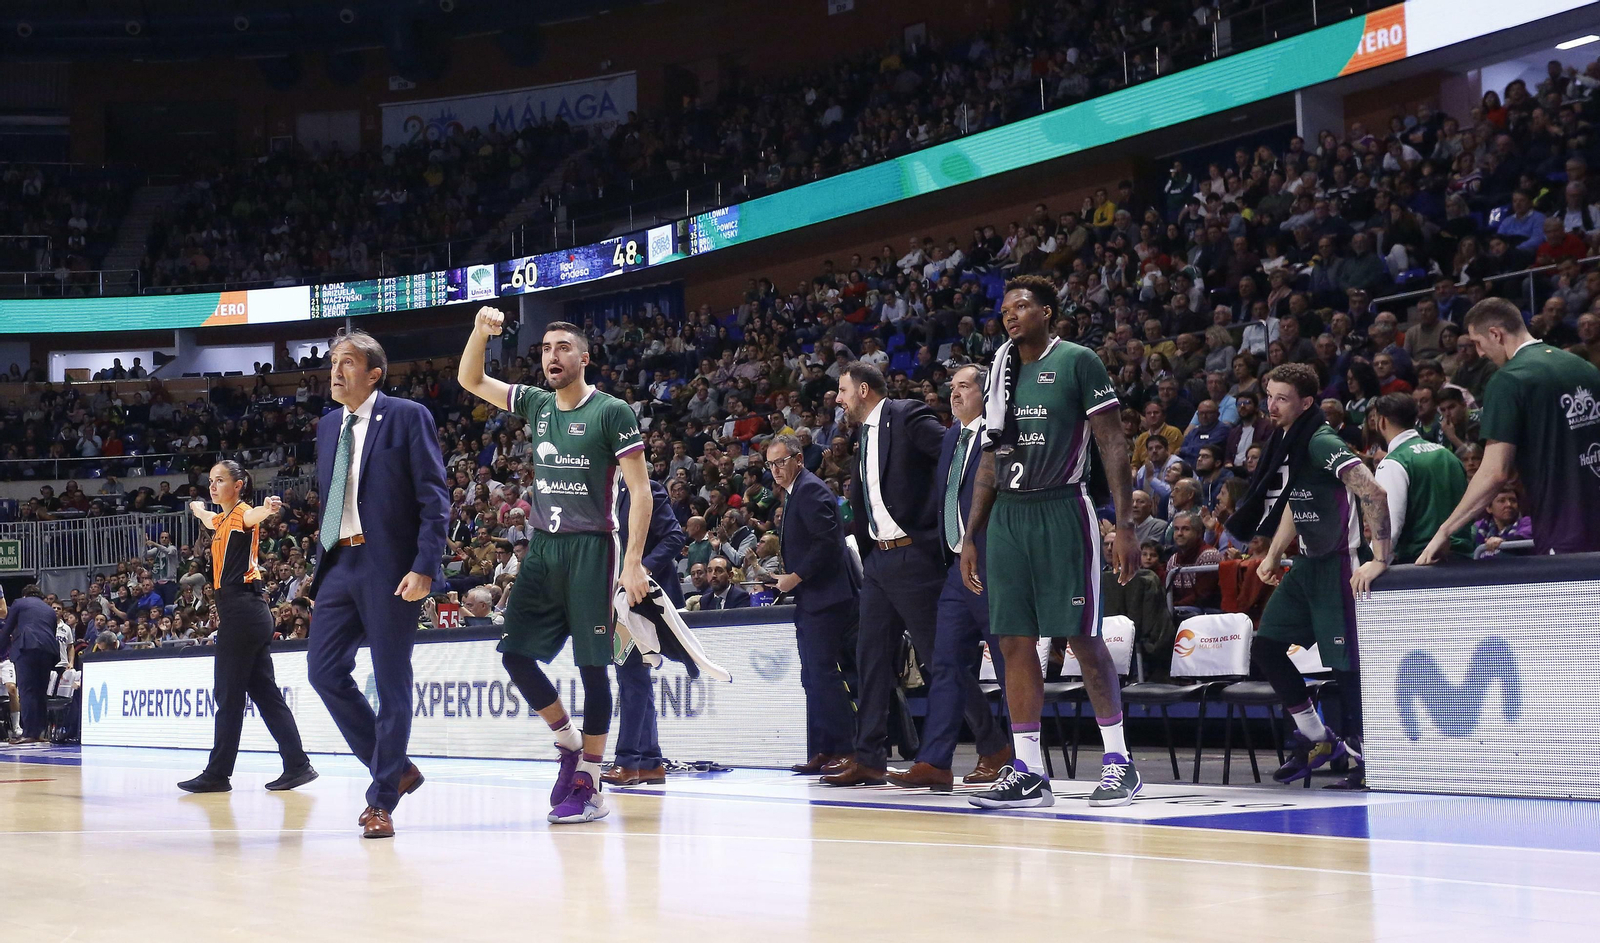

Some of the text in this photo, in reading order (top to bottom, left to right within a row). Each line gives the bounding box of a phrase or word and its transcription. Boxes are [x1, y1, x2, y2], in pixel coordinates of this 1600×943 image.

[698, 206, 729, 222] CALLOWAY
[511, 240, 639, 289] 60 liga 48
[384, 277, 397, 285] PTS
[413, 273, 426, 281] REB
[560, 266, 590, 281] endesa
[322, 287, 356, 298] BRIZUELA
[384, 284, 397, 292] PTS
[413, 280, 426, 288] REB
[384, 291, 397, 299] PTS
[413, 287, 426, 295] REB
[471, 287, 493, 297] Unicaja
[384, 298, 397, 306] PTS
[413, 294, 427, 302] REB
[384, 304, 397, 312] PTS
[1013, 404, 1048, 418] Unicaja
[1017, 431, 1046, 443] ÁLAGA
[554, 453, 590, 467] Unicaja
[1009, 462, 1024, 489] 2
[550, 479, 589, 492] MÁLAGA
[548, 504, 563, 534] 3
[1293, 510, 1319, 520] ÁLAGA
[7, 546, 16, 555] DE
[440, 610, 458, 629] 55
[122, 688, 191, 717] EXPERTOS
[195, 688, 215, 717] EN
[413, 681, 522, 717] XPERTOS
